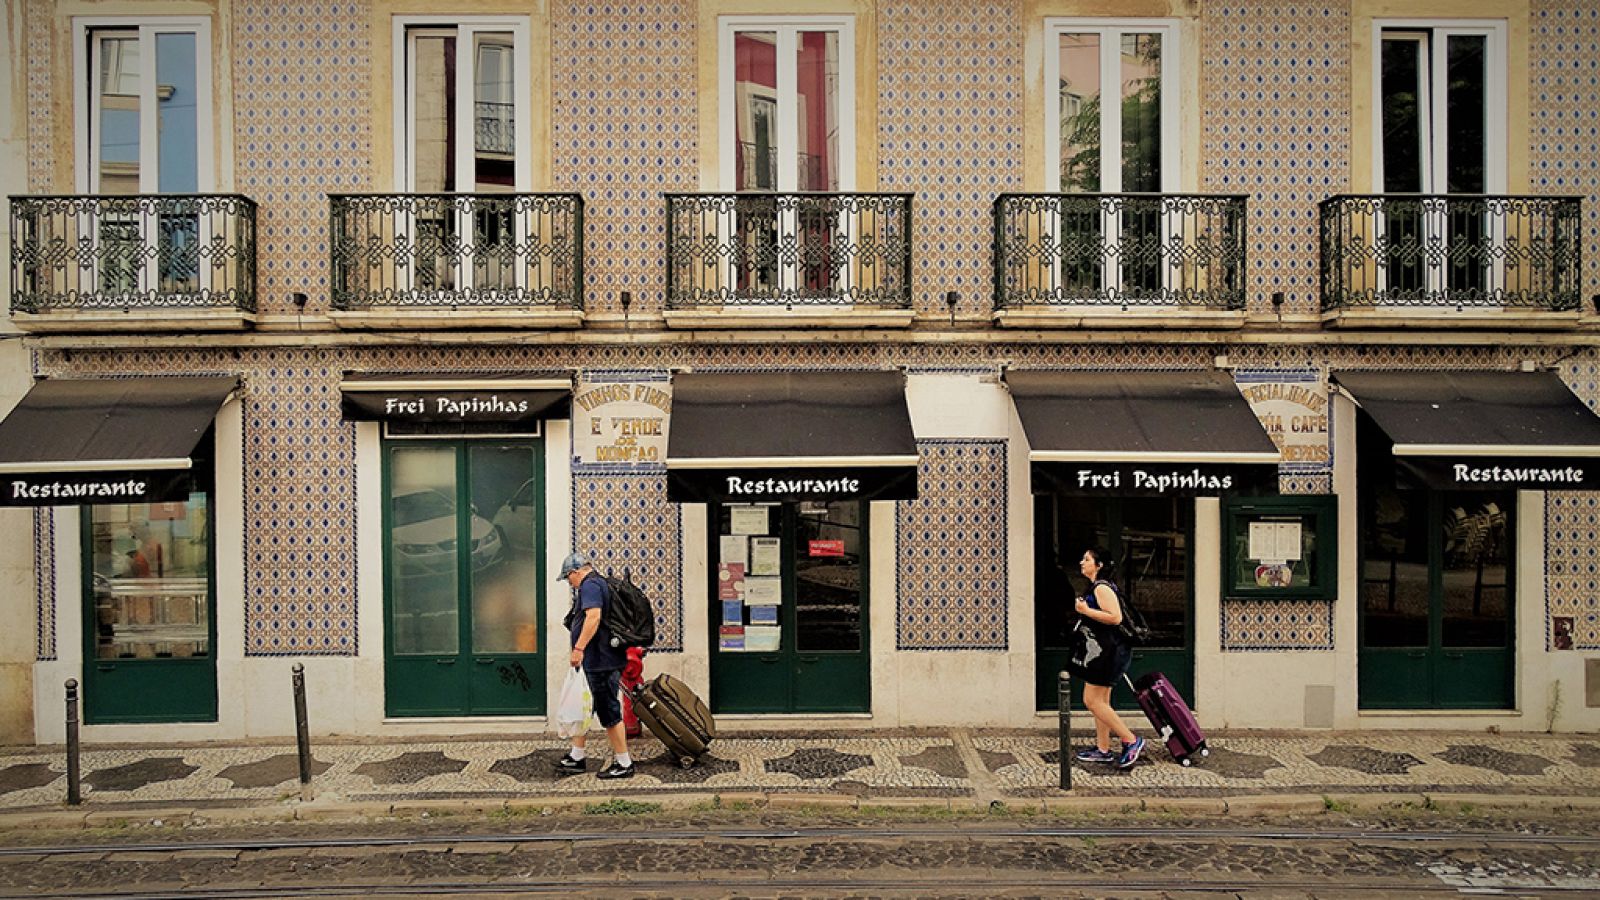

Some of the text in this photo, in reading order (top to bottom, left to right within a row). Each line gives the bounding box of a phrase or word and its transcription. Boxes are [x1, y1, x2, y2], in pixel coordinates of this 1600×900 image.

[385, 395, 528, 417] Frei Papinhas
[574, 384, 630, 412] VINHOS
[591, 417, 601, 435] E
[1077, 468, 1233, 493] Frei Papinhas
[1453, 463, 1584, 482] Restaurante
[11, 479, 146, 499] Restaurante
[726, 476, 860, 494] Restaurante
